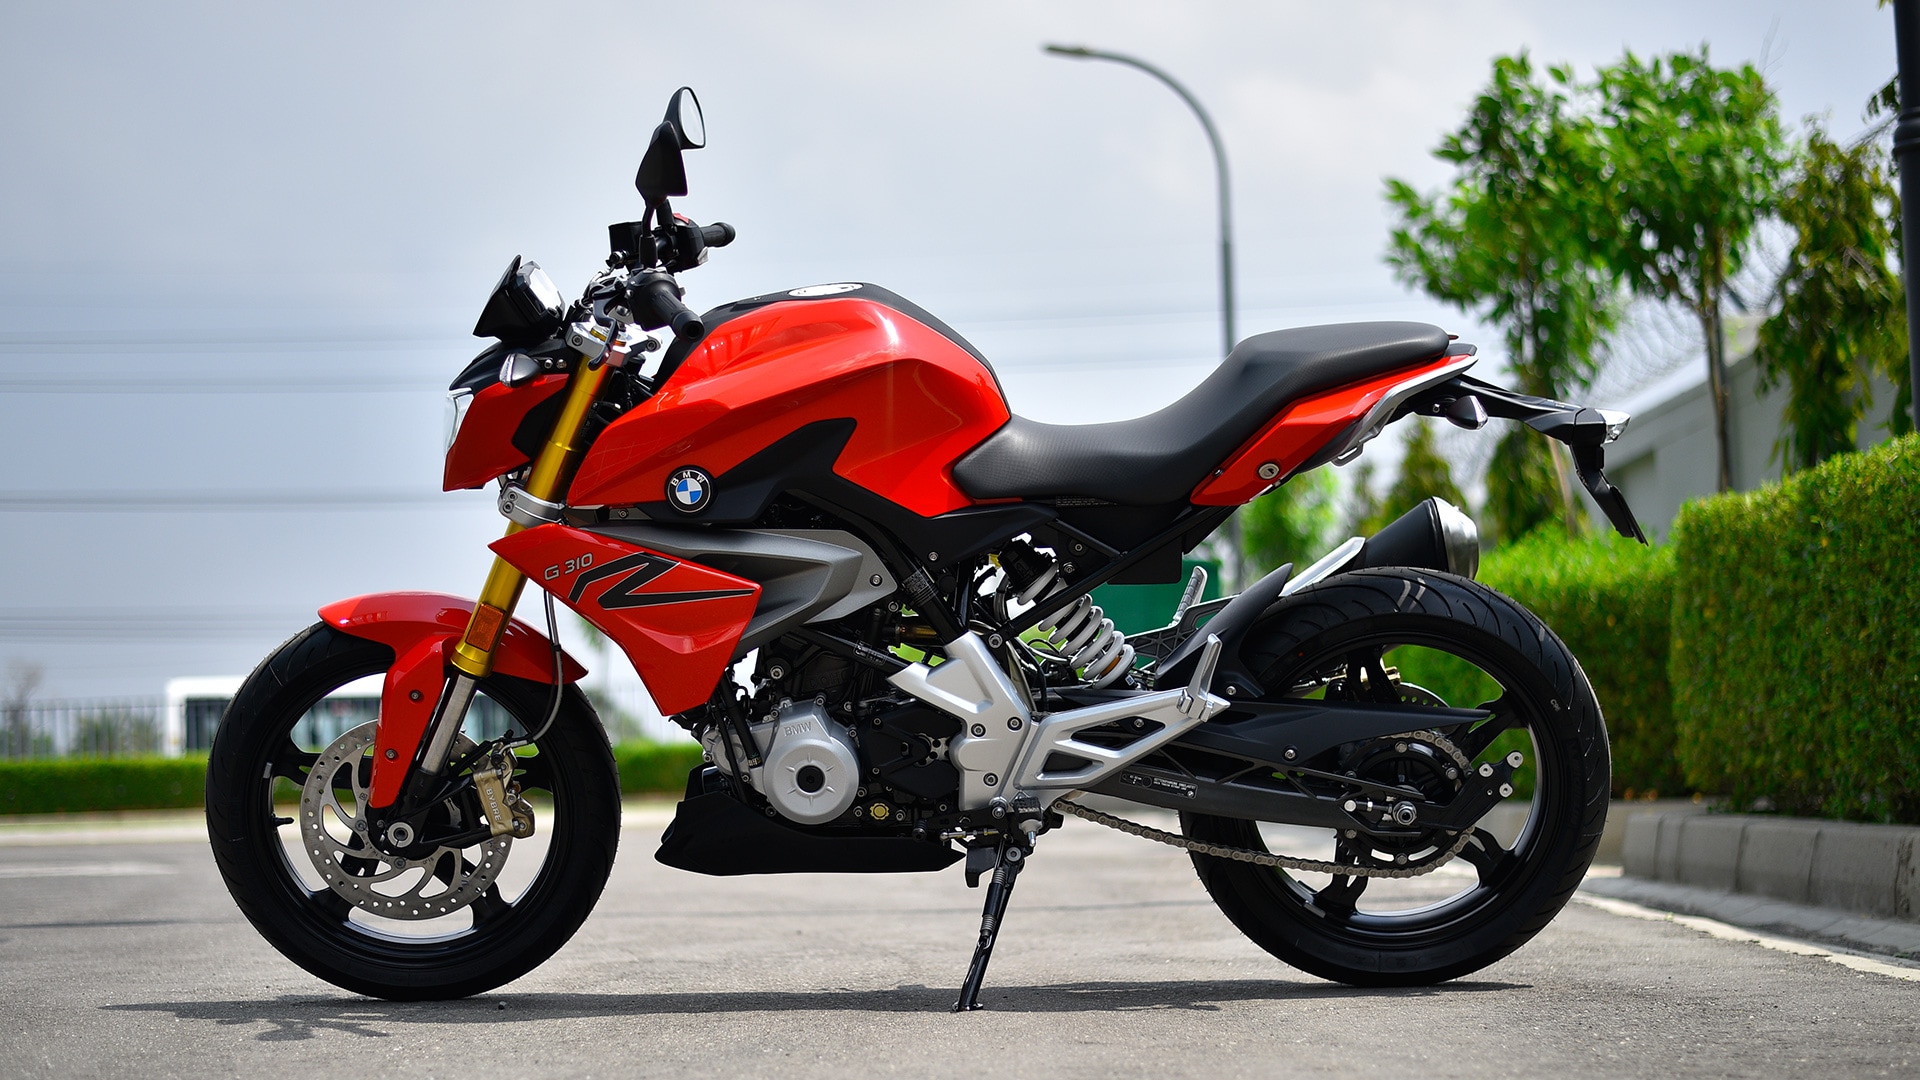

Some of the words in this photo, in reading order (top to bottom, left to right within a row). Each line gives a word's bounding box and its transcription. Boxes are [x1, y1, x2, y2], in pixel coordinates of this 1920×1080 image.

[671, 471, 705, 487] BMW
[544, 564, 560, 580] G
[564, 553, 593, 575] 310
[783, 721, 812, 736] BMW
[486, 788, 502, 821] BYBRE
